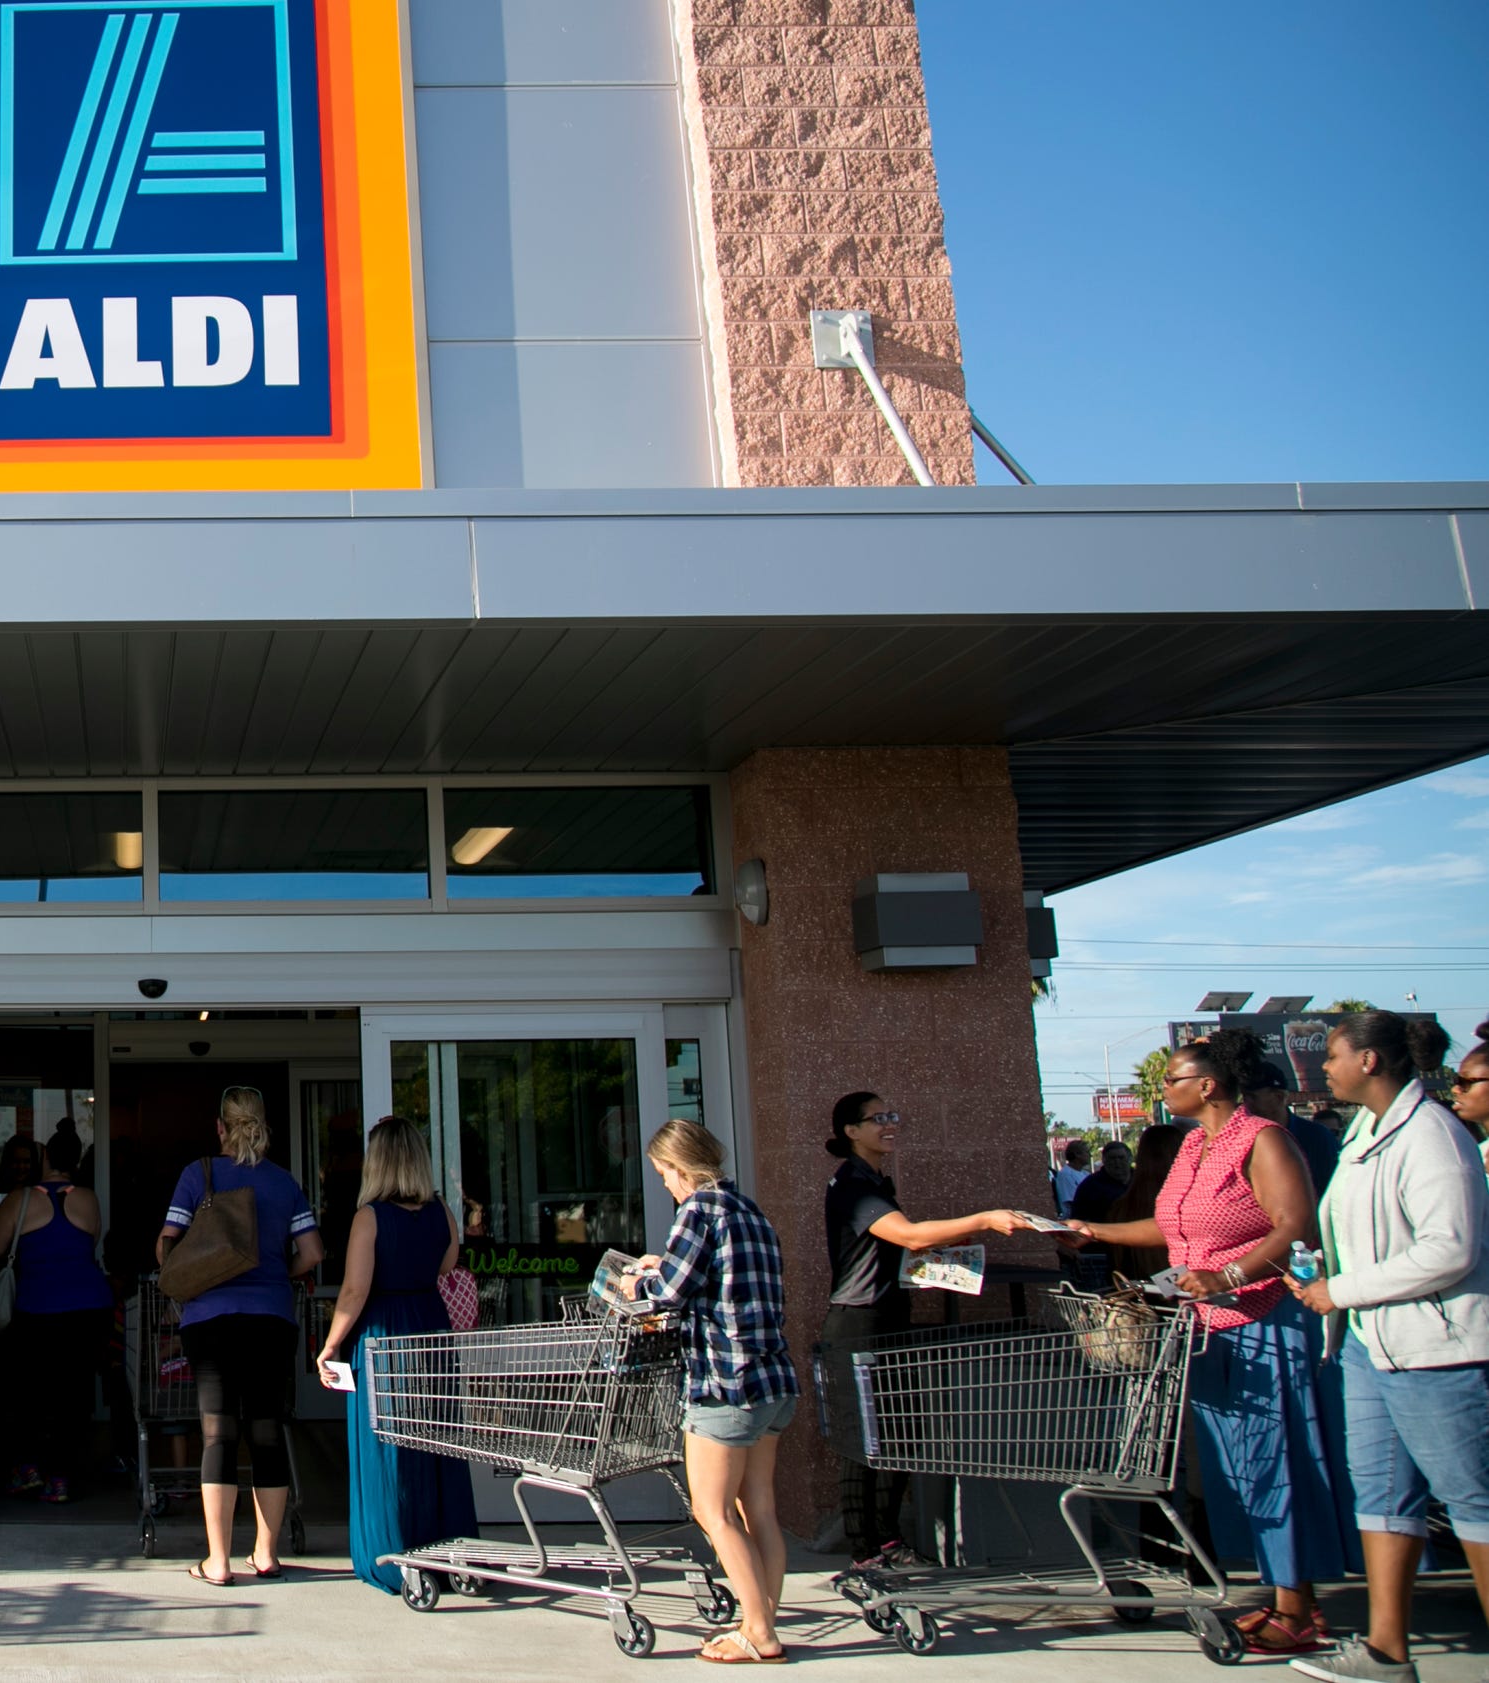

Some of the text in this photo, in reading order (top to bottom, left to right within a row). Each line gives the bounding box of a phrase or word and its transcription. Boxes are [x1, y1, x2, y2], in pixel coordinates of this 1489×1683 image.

[0, 295, 300, 390] ALDI
[1287, 1032, 1327, 1052] Coca-Col
[465, 1247, 580, 1275] Welcome
